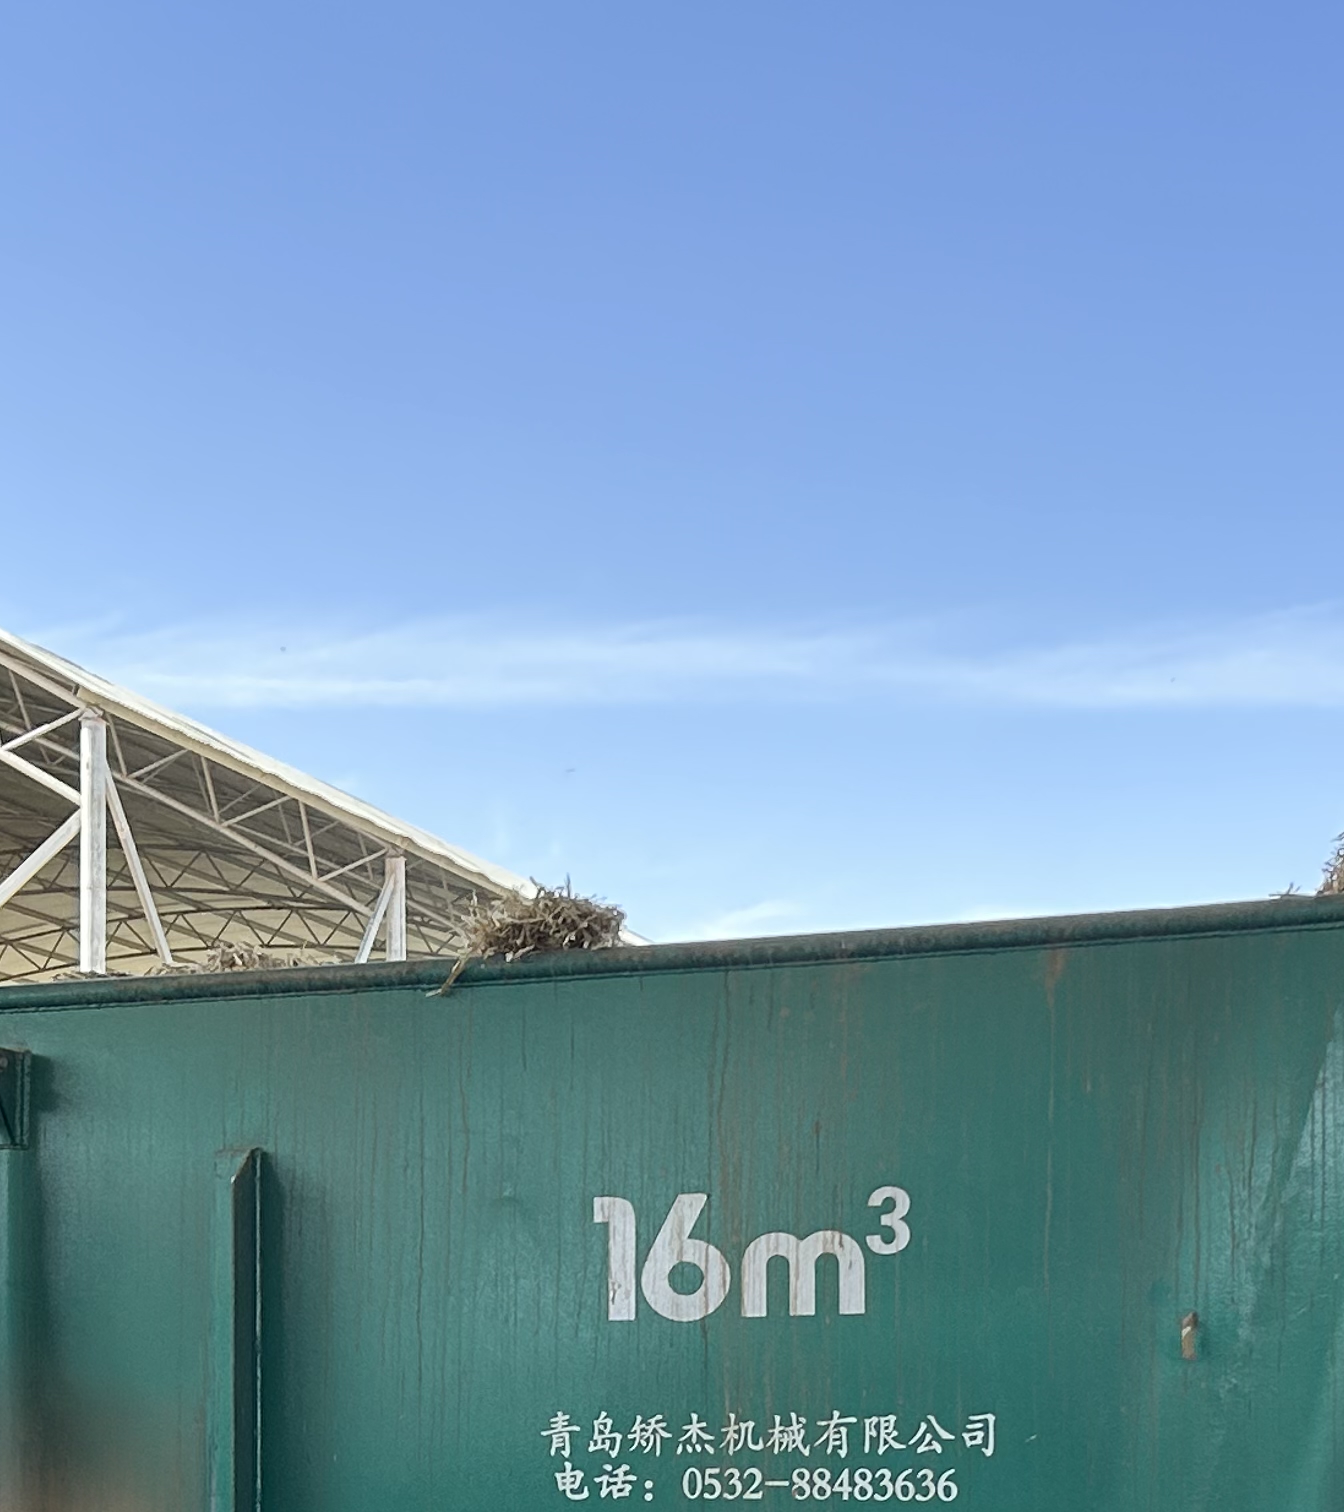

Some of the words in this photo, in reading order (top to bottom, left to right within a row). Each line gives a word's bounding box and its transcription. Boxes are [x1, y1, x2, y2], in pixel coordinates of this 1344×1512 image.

[540, 1410, 997, 1458] 青岛矫杰机械有限公司
